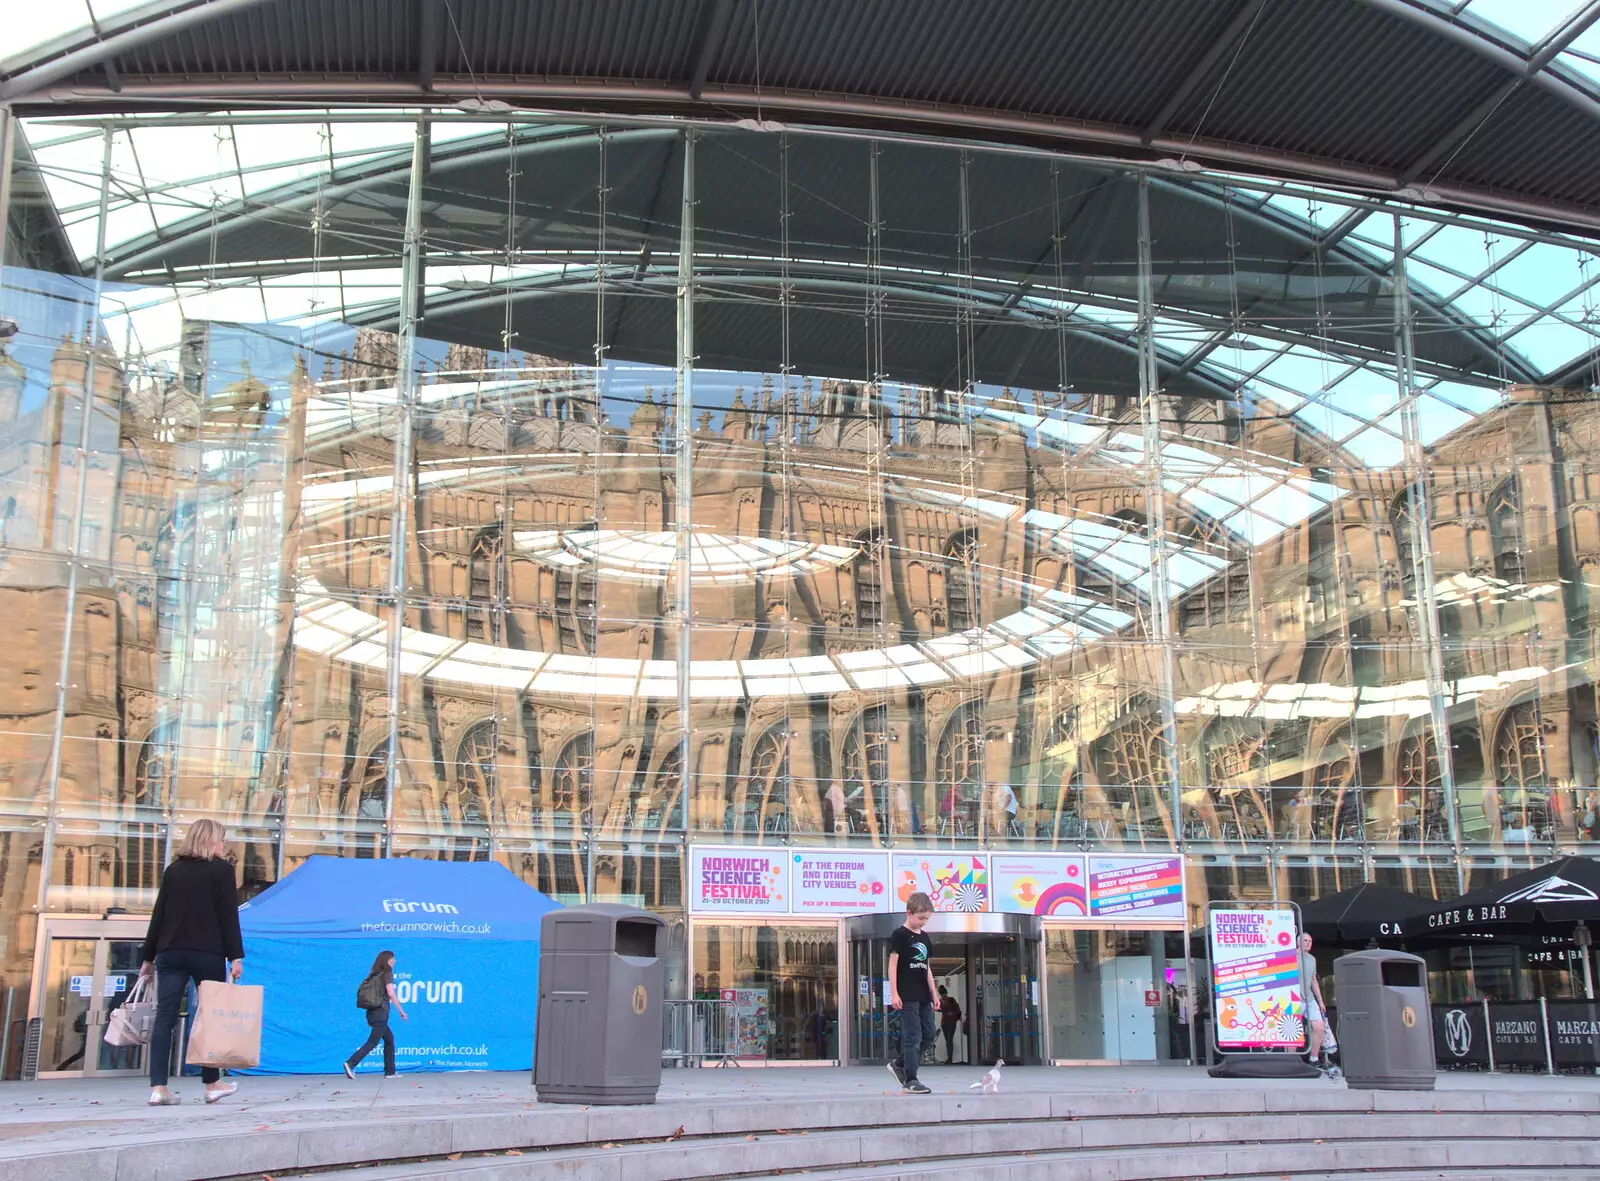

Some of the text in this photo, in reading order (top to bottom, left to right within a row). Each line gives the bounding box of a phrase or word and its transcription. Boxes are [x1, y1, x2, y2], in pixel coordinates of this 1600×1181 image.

[702, 857, 769, 872] NORWICH
[803, 861, 865, 870] AT THE FORUM
[702, 871, 761, 885] SCIENCE
[803, 871, 820, 879] AND
[803, 880, 857, 889] CITY VENUES
[702, 885, 770, 899] FESTIVAL
[1216, 913, 1264, 924] NORWICH
[1428, 905, 1507, 928] CAFE & BAR
[361, 921, 491, 934] theforumnorwich.co.uk
[1216, 924, 1259, 933] SCIENCE
[1217, 934, 1266, 943] FESTIVAL
[390, 980, 463, 1004] orum
[1496, 1021, 1537, 1034] MARZANO
[1496, 1035, 1512, 1043] CAFE
[1559, 1036, 1582, 1044] CAFE
